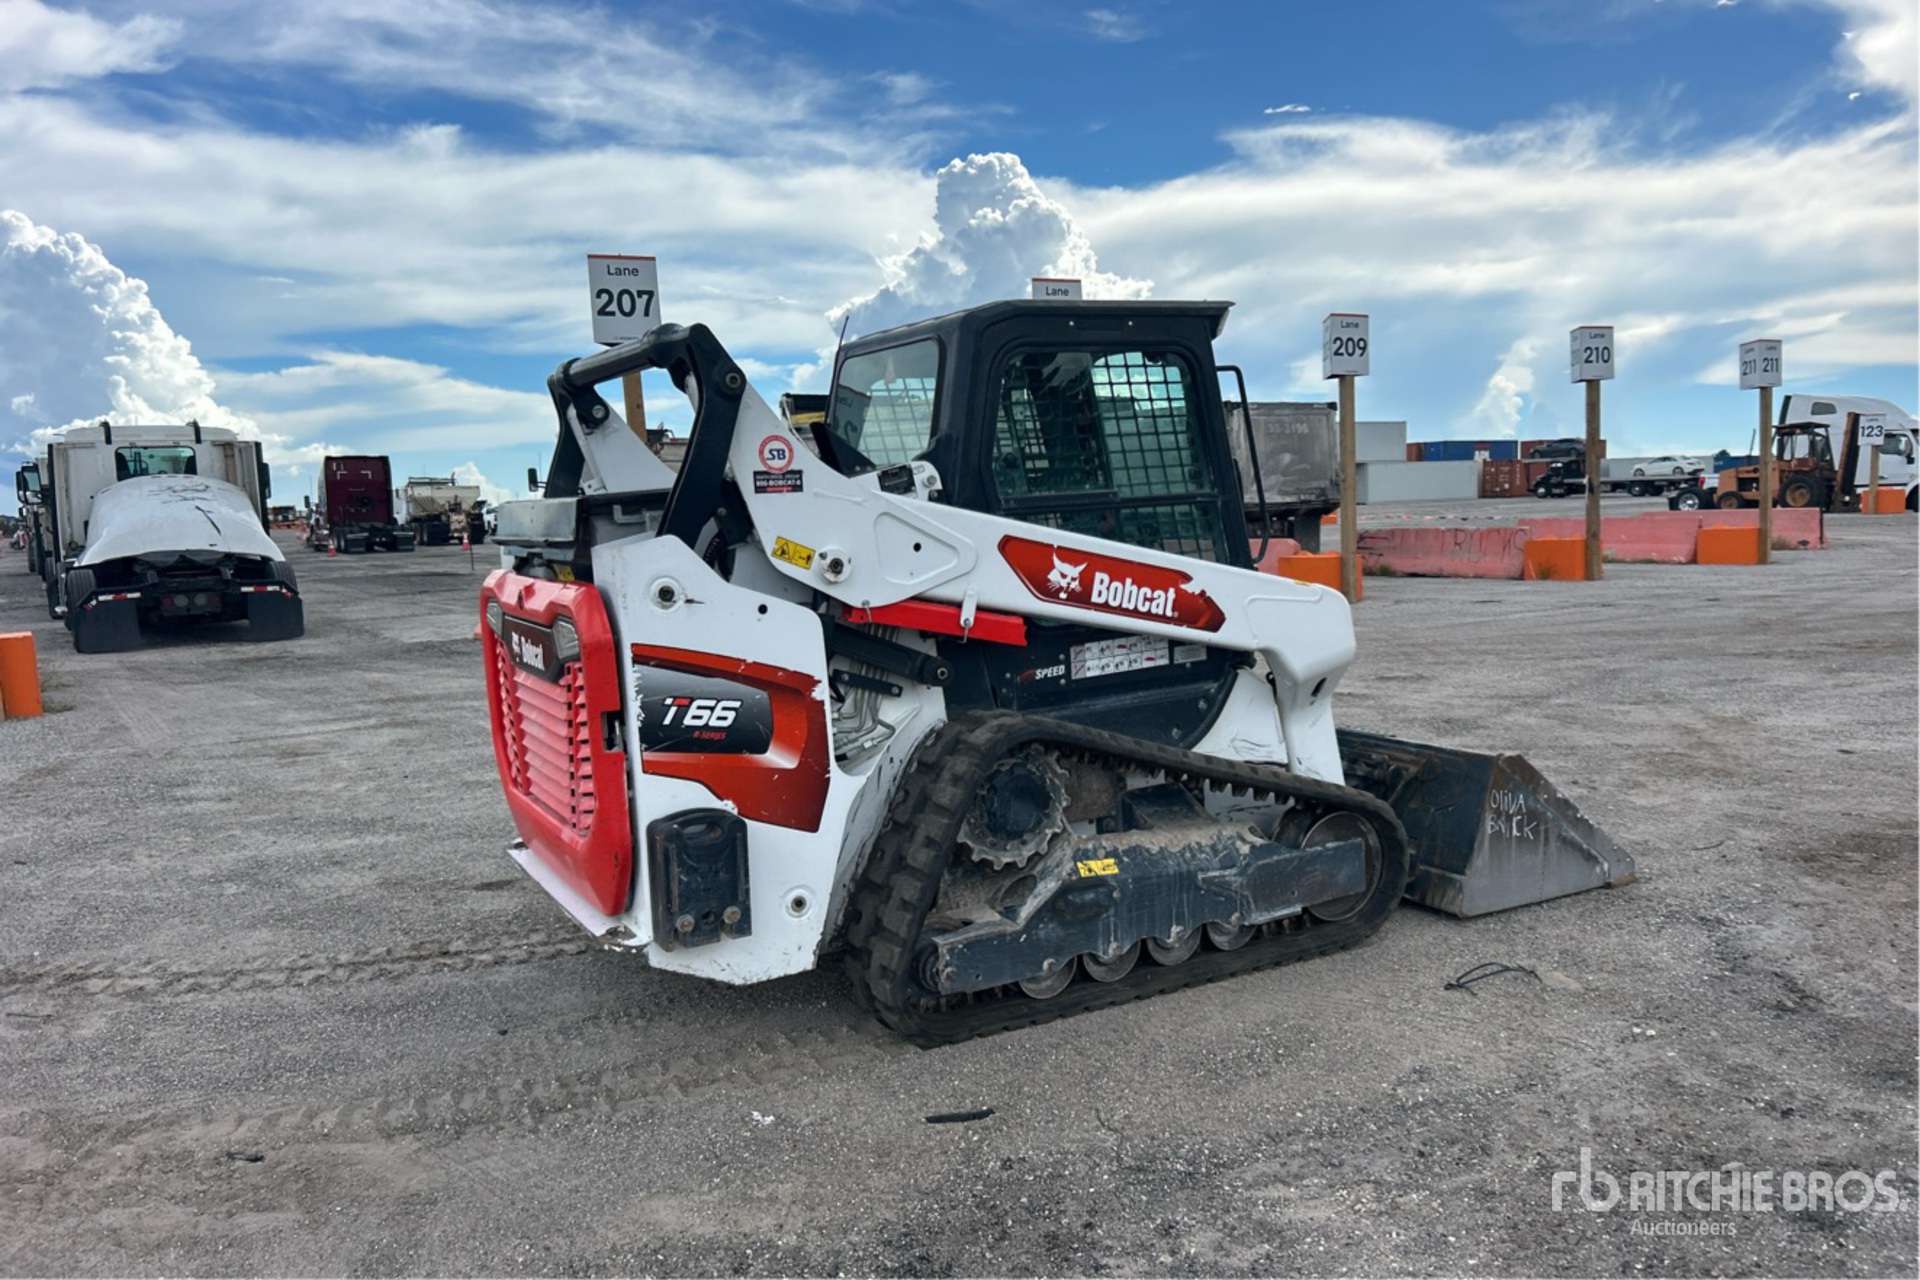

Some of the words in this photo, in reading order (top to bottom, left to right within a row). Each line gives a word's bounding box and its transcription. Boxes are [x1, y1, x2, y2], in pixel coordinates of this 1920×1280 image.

[606, 264, 639, 277] Lane
[1045, 285, 1069, 297] Lane
[595, 288, 655, 318] 207
[1340, 320, 1359, 329] Lane
[1333, 336, 1367, 358] 209
[1584, 346, 1611, 364] 210
[1742, 358, 1757, 377] 211
[1762, 356, 1779, 373] 211
[1860, 424, 1884, 438] 123
[1091, 571, 1176, 618] Bobcat
[662, 697, 742, 728] T66
